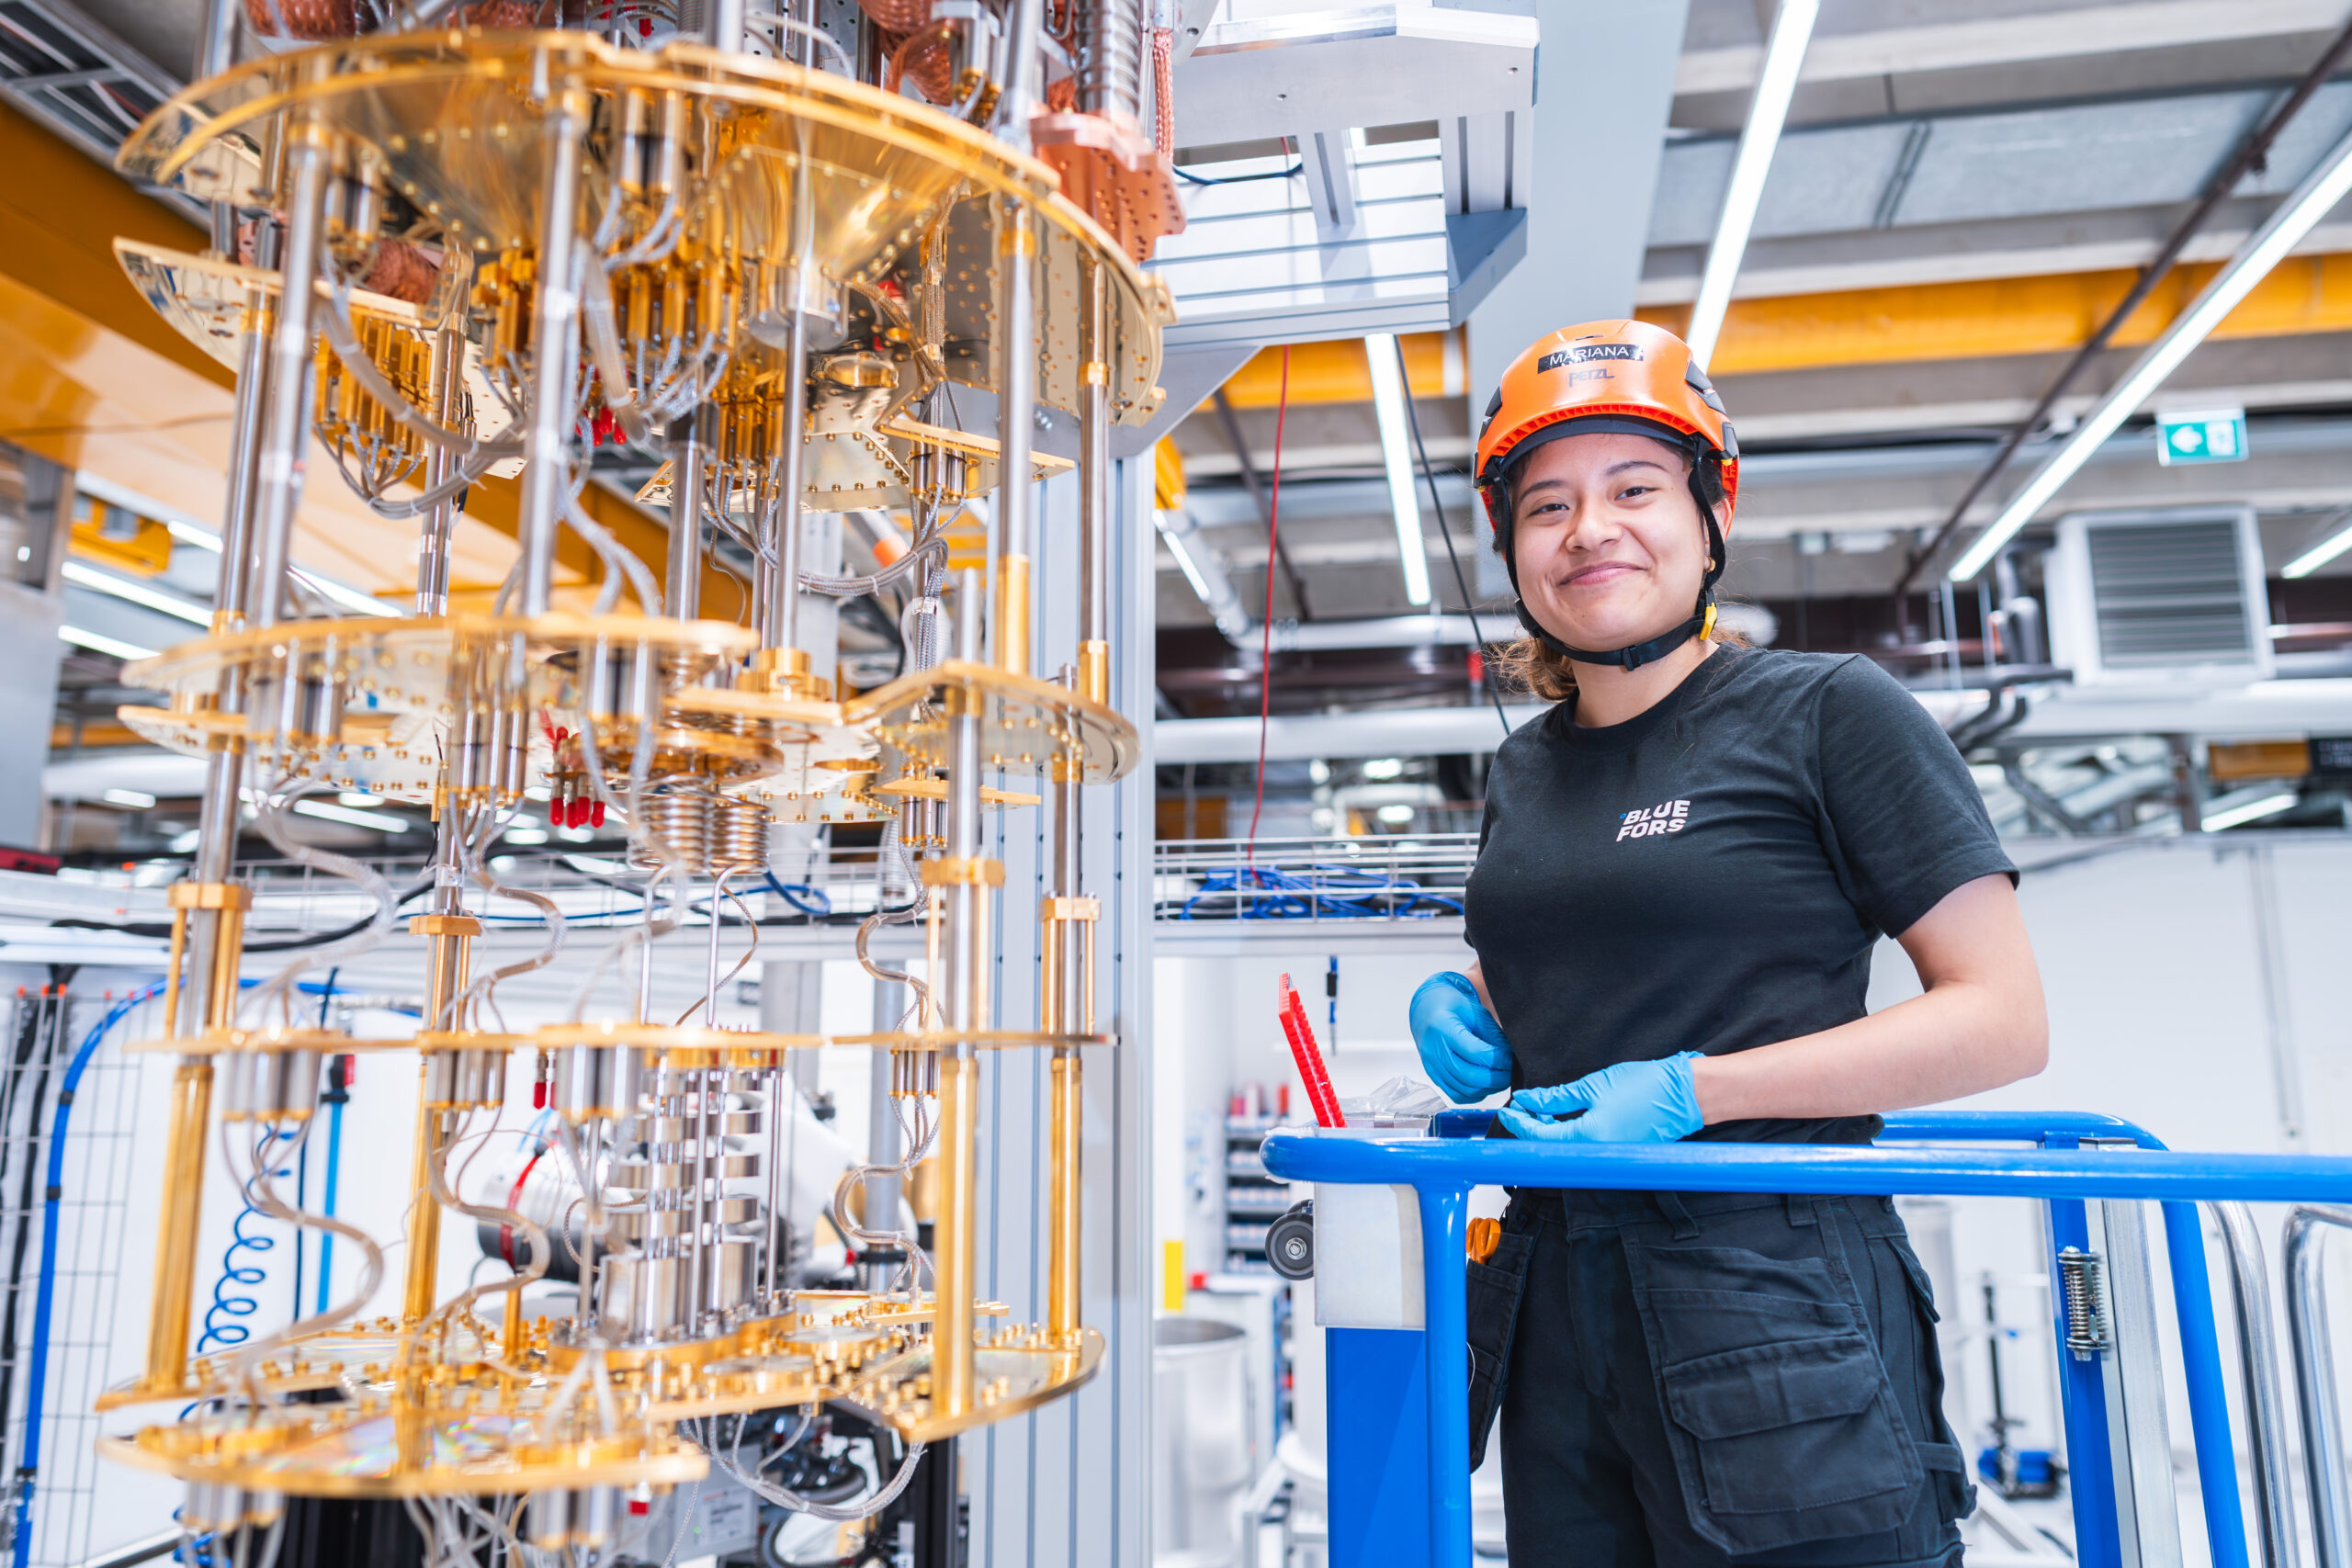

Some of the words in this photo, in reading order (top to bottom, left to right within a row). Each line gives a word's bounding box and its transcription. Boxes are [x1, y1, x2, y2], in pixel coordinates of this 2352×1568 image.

[1549, 346, 1629, 366] MARIANA
[1568, 368, 1615, 388] PETZL
[1623, 800, 1690, 826] BLUE
[1616, 818, 1687, 841] FORS
